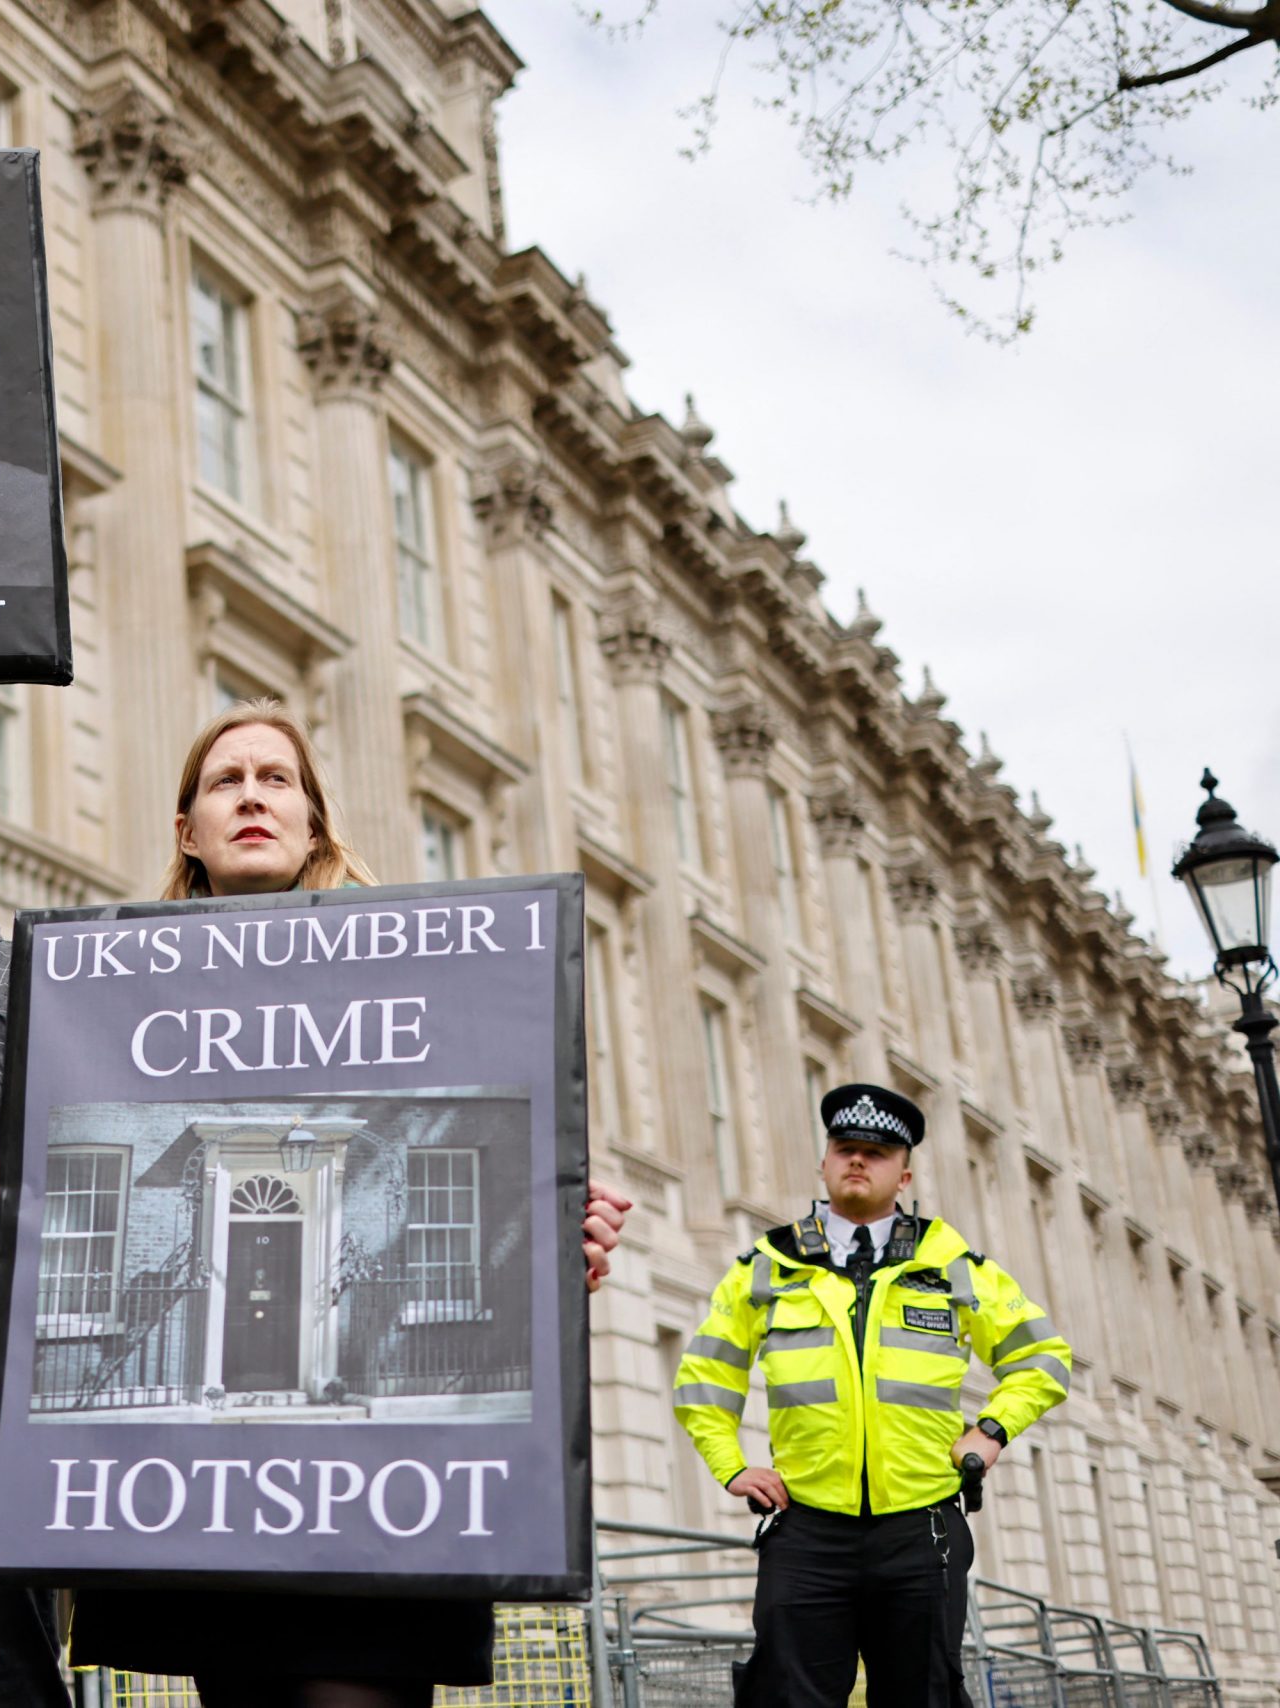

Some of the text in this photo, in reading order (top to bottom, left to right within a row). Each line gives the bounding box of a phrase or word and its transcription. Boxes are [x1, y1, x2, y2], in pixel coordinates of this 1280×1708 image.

[43, 901, 546, 981] UK'S NUMBER 1
[131, 996, 431, 1077] CRIME
[256, 1236, 270, 1245] 10
[45, 1458, 508, 1537] HOTSPOT
